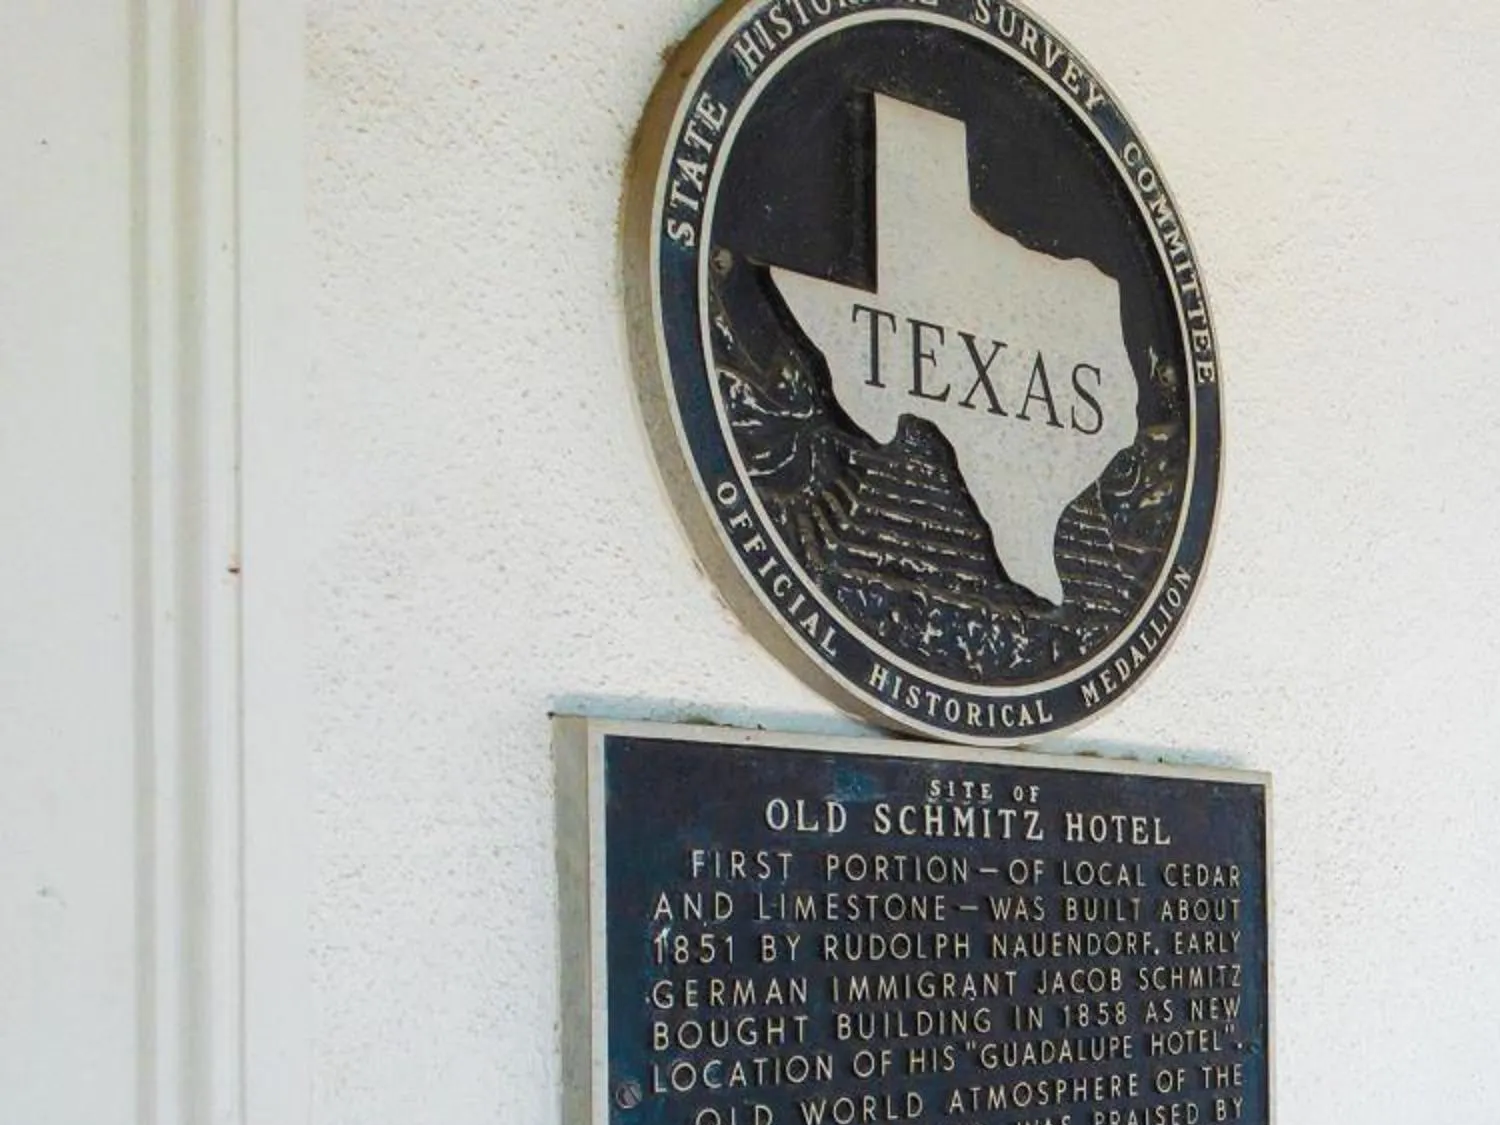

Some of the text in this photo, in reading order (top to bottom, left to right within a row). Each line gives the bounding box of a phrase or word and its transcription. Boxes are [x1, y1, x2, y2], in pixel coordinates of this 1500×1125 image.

[666, 96, 728, 247] STATE
[971, 0, 1105, 112] SURVEY
[1119, 140, 1217, 386] COMMITTEE
[851, 303, 1107, 436] TEXAS
[716, 480, 1195, 728] OFFICIAL HISTORICAL MEDALLION
[927, 779, 1041, 802] SITE OF
[765, 798, 1171, 845] OLD SCHMITZ HOTEL
[692, 849, 793, 880] FIRST
[1062, 860, 1147, 887] LOCAL
[1163, 863, 1241, 888] CEDAR
[653, 892, 733, 920] AND
[1067, 898, 1141, 922] BUILT
[1161, 899, 1241, 922] ABOUT
[653, 932, 735, 964] 1851
[761, 933, 801, 962] BY
[824, 931, 970, 960] RUDOLPH
[1174, 931, 1241, 953] EARLY
[652, 964, 1241, 1009] GERMAN IMMIGRANT JACOB SCHMITZ
[653, 996, 1241, 1051] BOUGHT BUILDING IN 1858 AS NEW
[653, 1055, 834, 1093] LOCATION
[853, 1049, 892, 1078] OF
[909, 1045, 955, 1074] HIS
[965, 1035, 1133, 1069] "GUADALUPE
[949, 1073, 1140, 1114] ATMOSPHERE
[1156, 1068, 1186, 1093] OF
[1201, 1064, 1243, 1090] THE
[1216, 1098, 1244, 1121] BY
